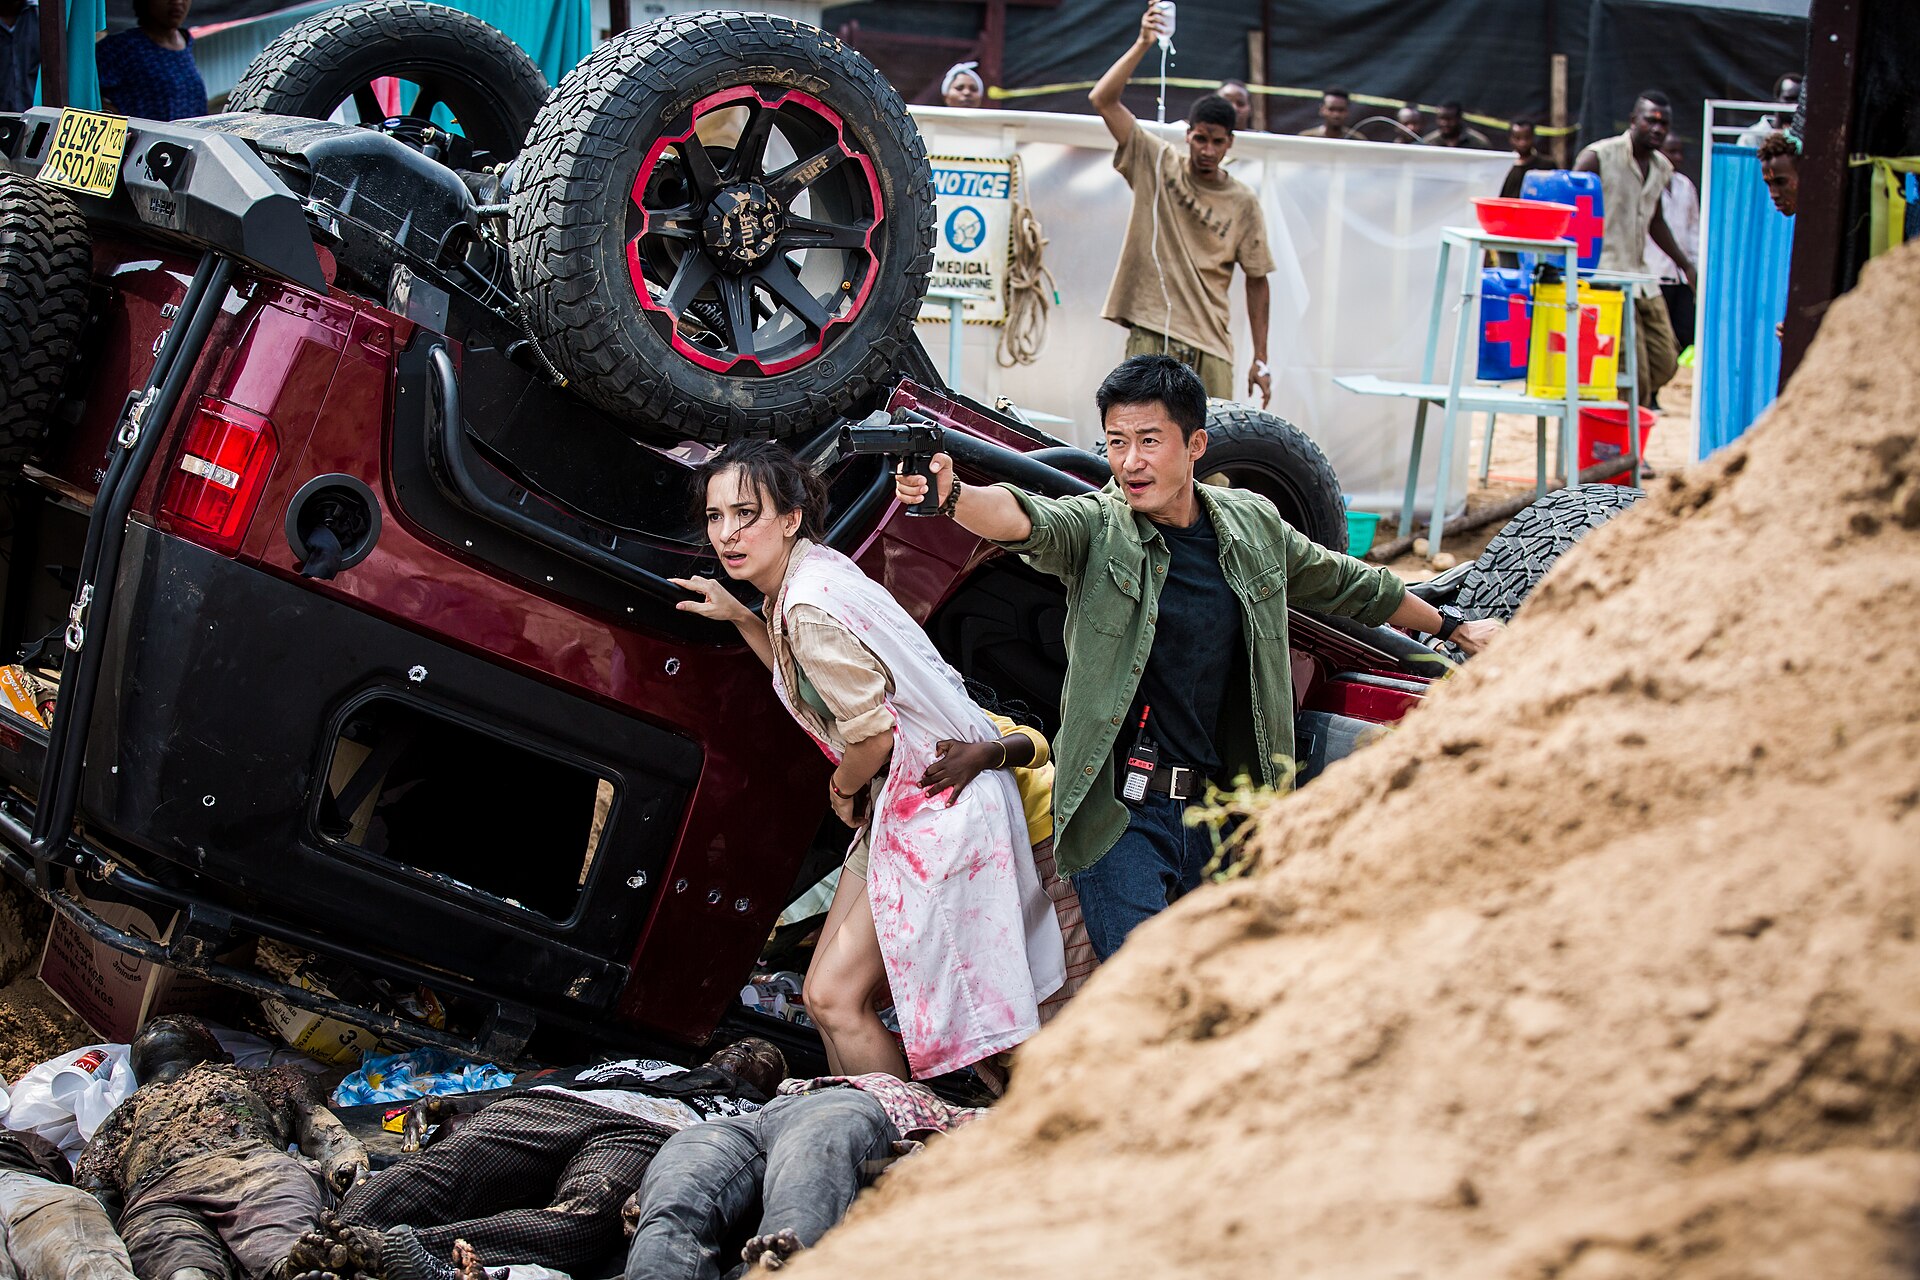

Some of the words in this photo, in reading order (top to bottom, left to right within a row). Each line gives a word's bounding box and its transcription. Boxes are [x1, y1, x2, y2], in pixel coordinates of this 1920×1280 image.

[58, 115, 108, 154] 2457B
[42, 150, 94, 187] CQSU
[793, 155, 829, 184] TUFF
[933, 171, 1009, 198] NOTICE
[740, 212, 755, 248] TUFF
[936, 261, 991, 276] MEDICAL
[740, 370, 817, 399] FUEL
[338, 1029, 358, 1046] 3
